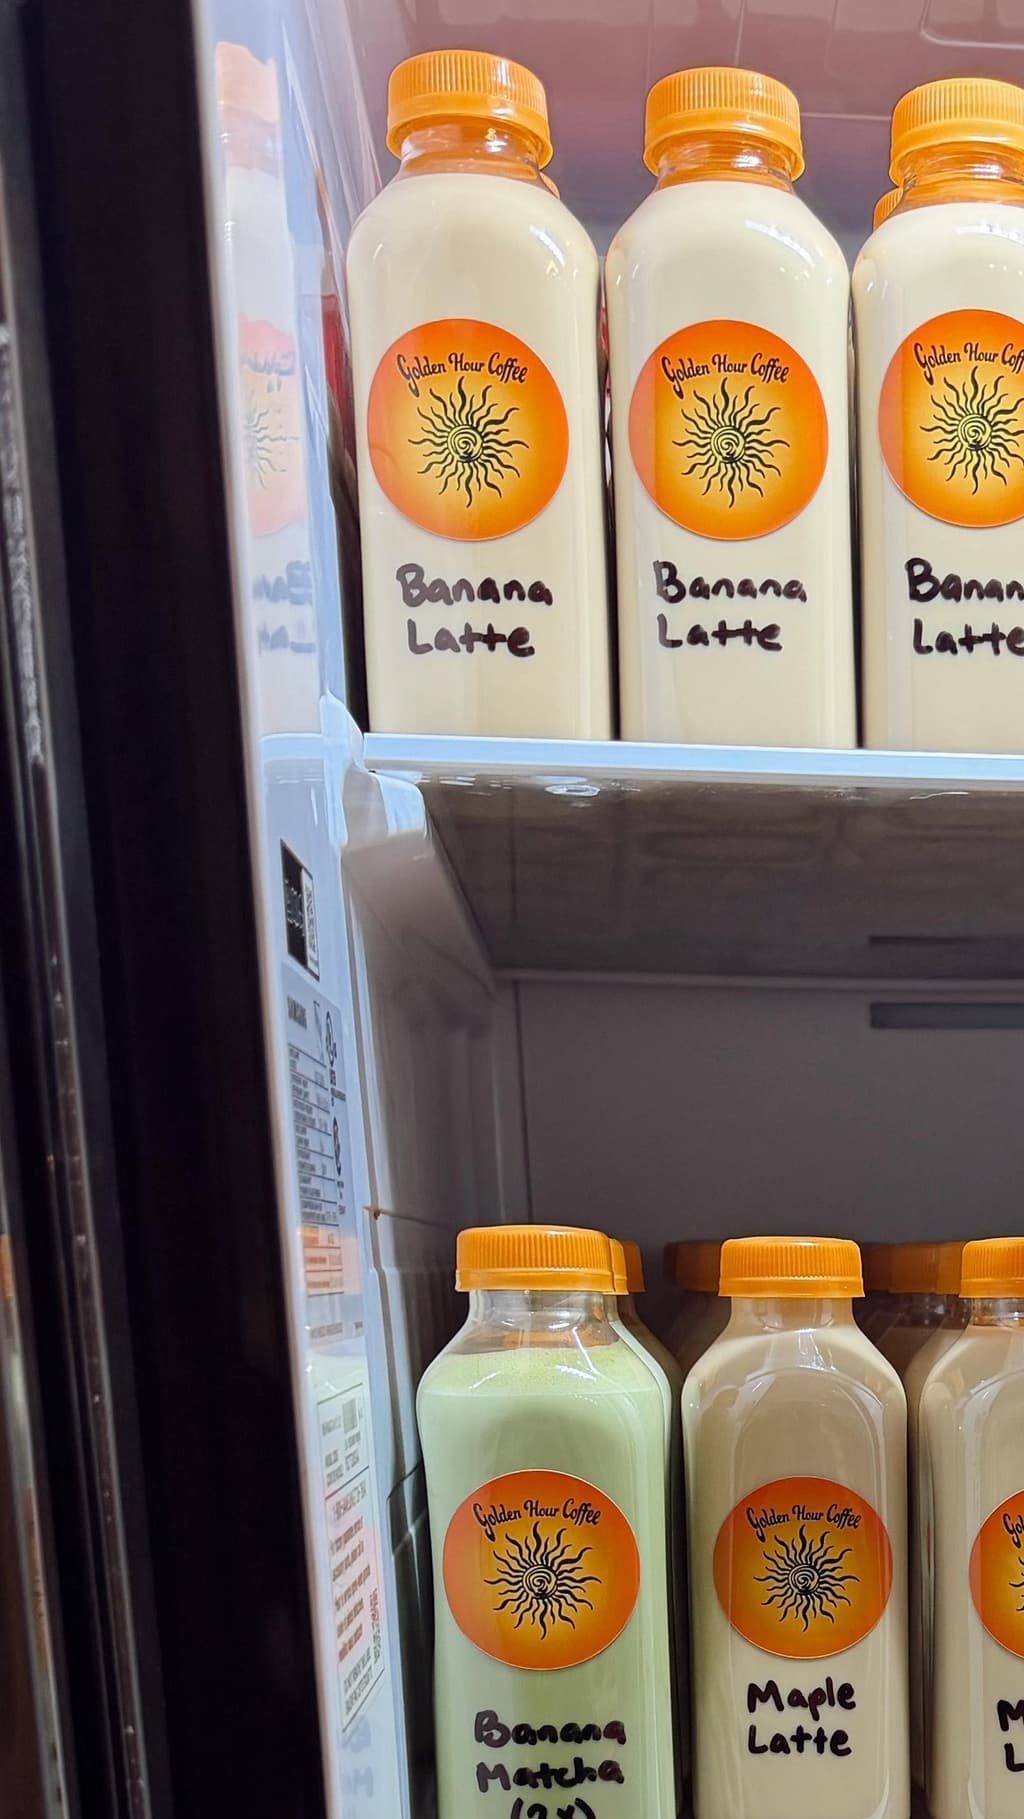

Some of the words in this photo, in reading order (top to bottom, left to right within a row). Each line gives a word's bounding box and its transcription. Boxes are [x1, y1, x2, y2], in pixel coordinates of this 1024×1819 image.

[397, 354, 446, 397] Golden
[448, 353, 484, 374] Hour
[488, 353, 527, 383] Coffee
[661, 356, 710, 398] Golden
[711, 354, 747, 375] Hour
[750, 353, 789, 383] Coffee
[914, 343, 961, 384] Golden
[963, 343, 998, 363] Hour
[396, 562, 553, 606] Banana
[653, 560, 806, 602] Banana
[406, 618, 535, 658] Latte
[657, 613, 782, 652] Latte
[473, 1503, 520, 1542] Golden
[524, 1501, 559, 1519] Hour
[562, 1498, 601, 1526] Coffee
[746, 1507, 789, 1543] Golden
[791, 1505, 823, 1522] Hour
[826, 1504, 861, 1530] Coffee
[747, 1677, 857, 1721] Maple
[474, 1710, 626, 1748] Banana
[747, 1725, 852, 1756] Latte
[476, 1758, 624, 1793] Matcha
